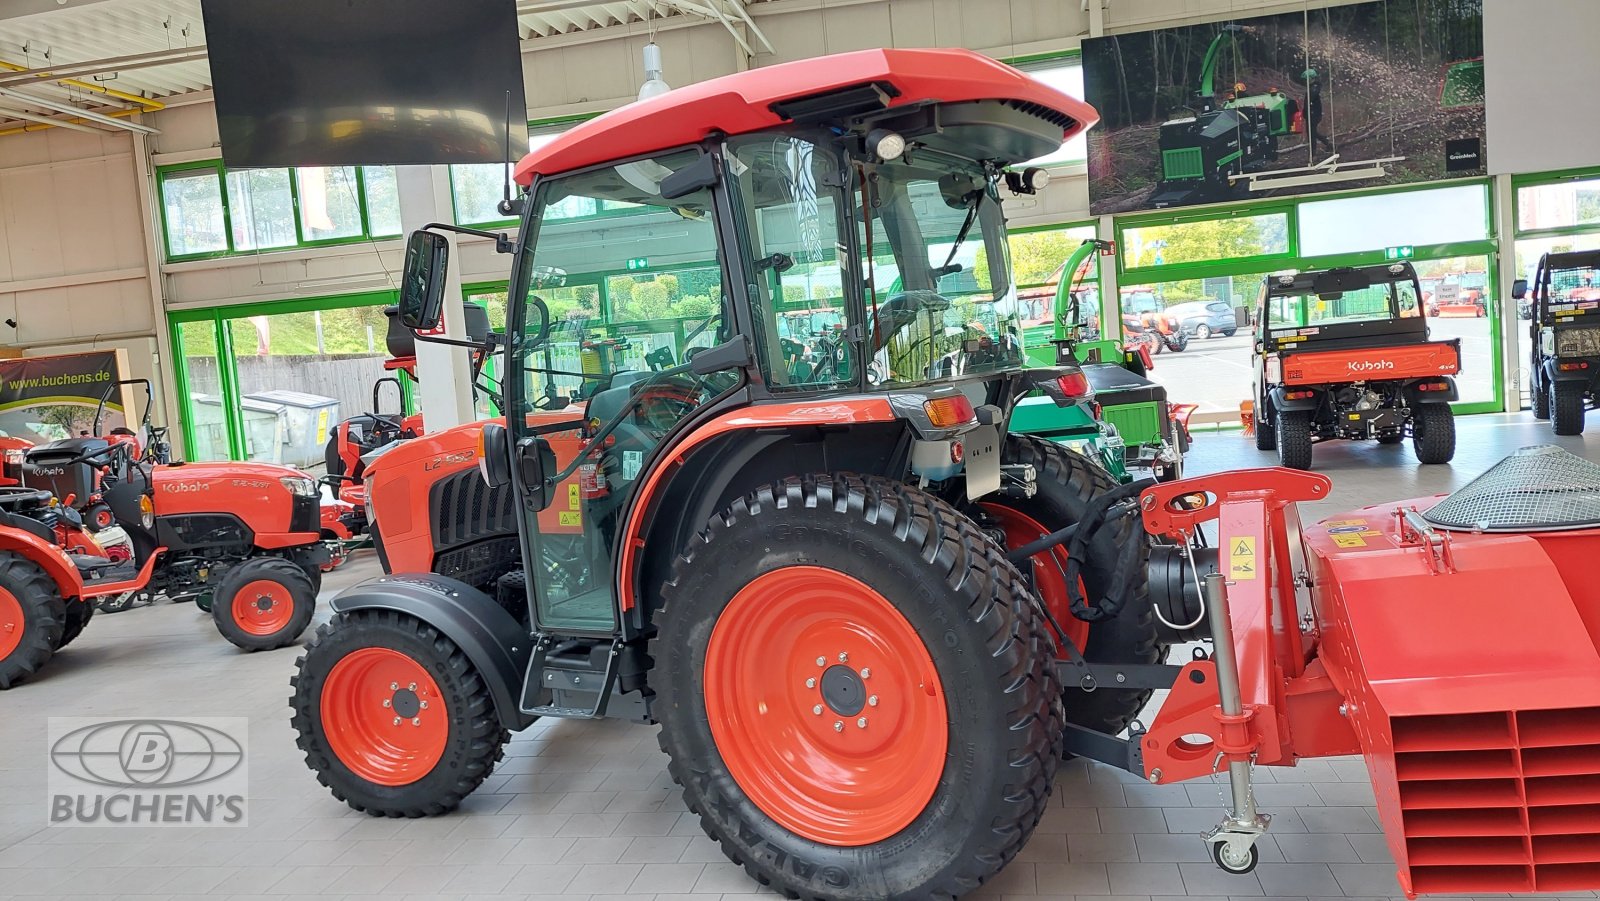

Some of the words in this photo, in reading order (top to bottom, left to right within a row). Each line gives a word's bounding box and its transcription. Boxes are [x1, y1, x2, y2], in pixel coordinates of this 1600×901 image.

[1449, 152, 1477, 160] GreenMech
[1348, 360, 1394, 371] Kubota
[9, 370, 110, 390] www.buchens.de
[32, 466, 65, 476] Kubota
[162, 481, 210, 493] Kubota
